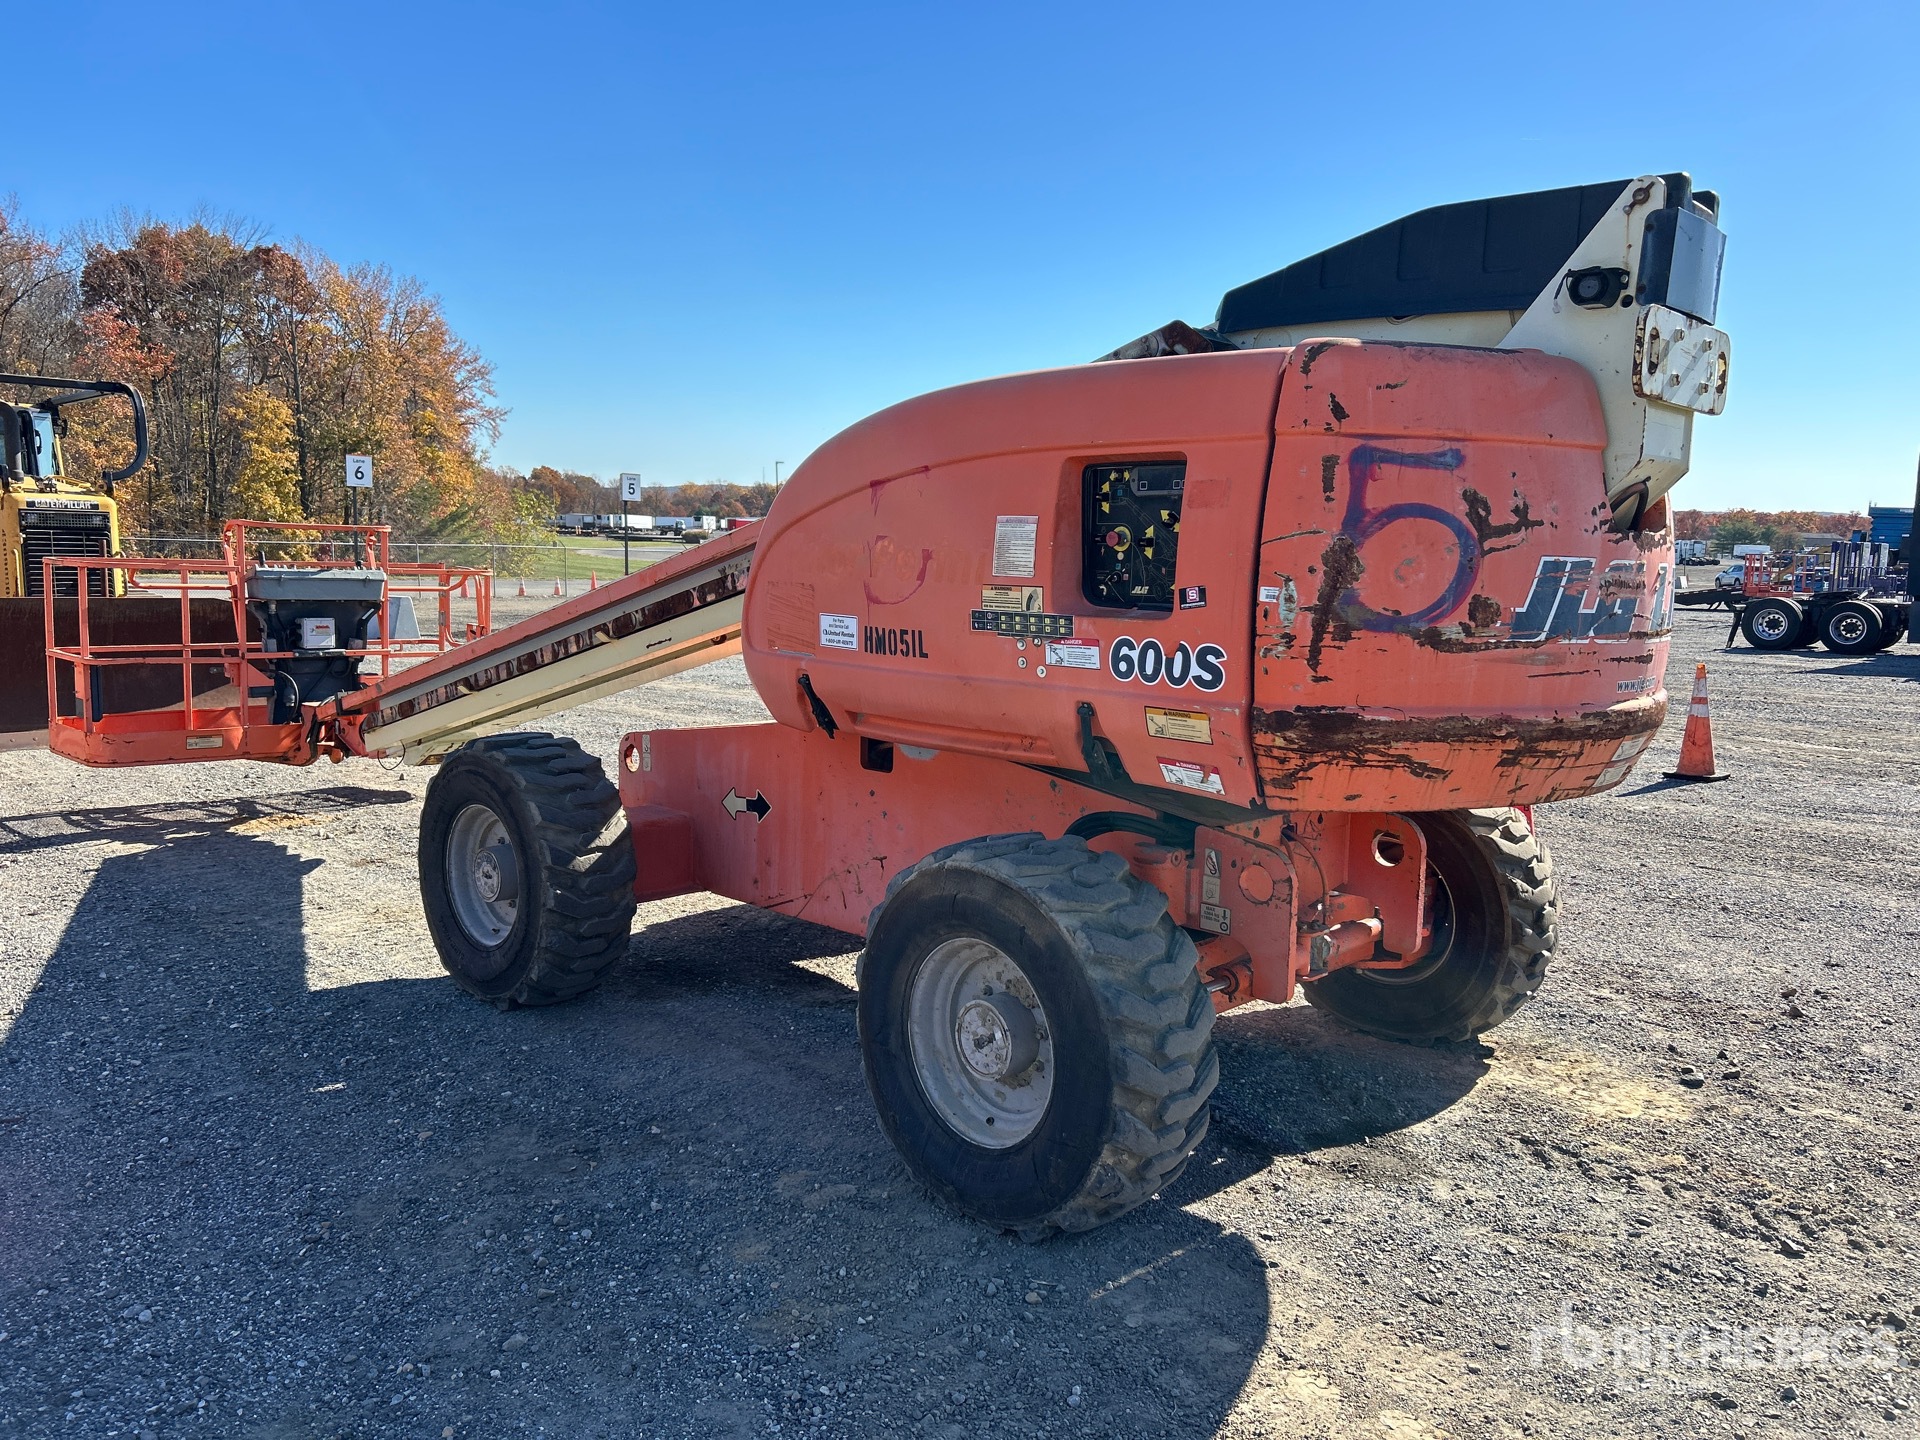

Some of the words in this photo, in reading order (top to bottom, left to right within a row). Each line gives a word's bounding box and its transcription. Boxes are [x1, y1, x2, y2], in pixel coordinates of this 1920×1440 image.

[354, 465, 365, 480] 6
[628, 482, 635, 495] 5
[34, 499, 92, 509] CATERPILLAR
[1335, 443, 1481, 633] 5
[1131, 585, 1149, 594] JLG
[1109, 635, 1228, 692] 600S
[1168, 711, 1192, 719] WARNING
